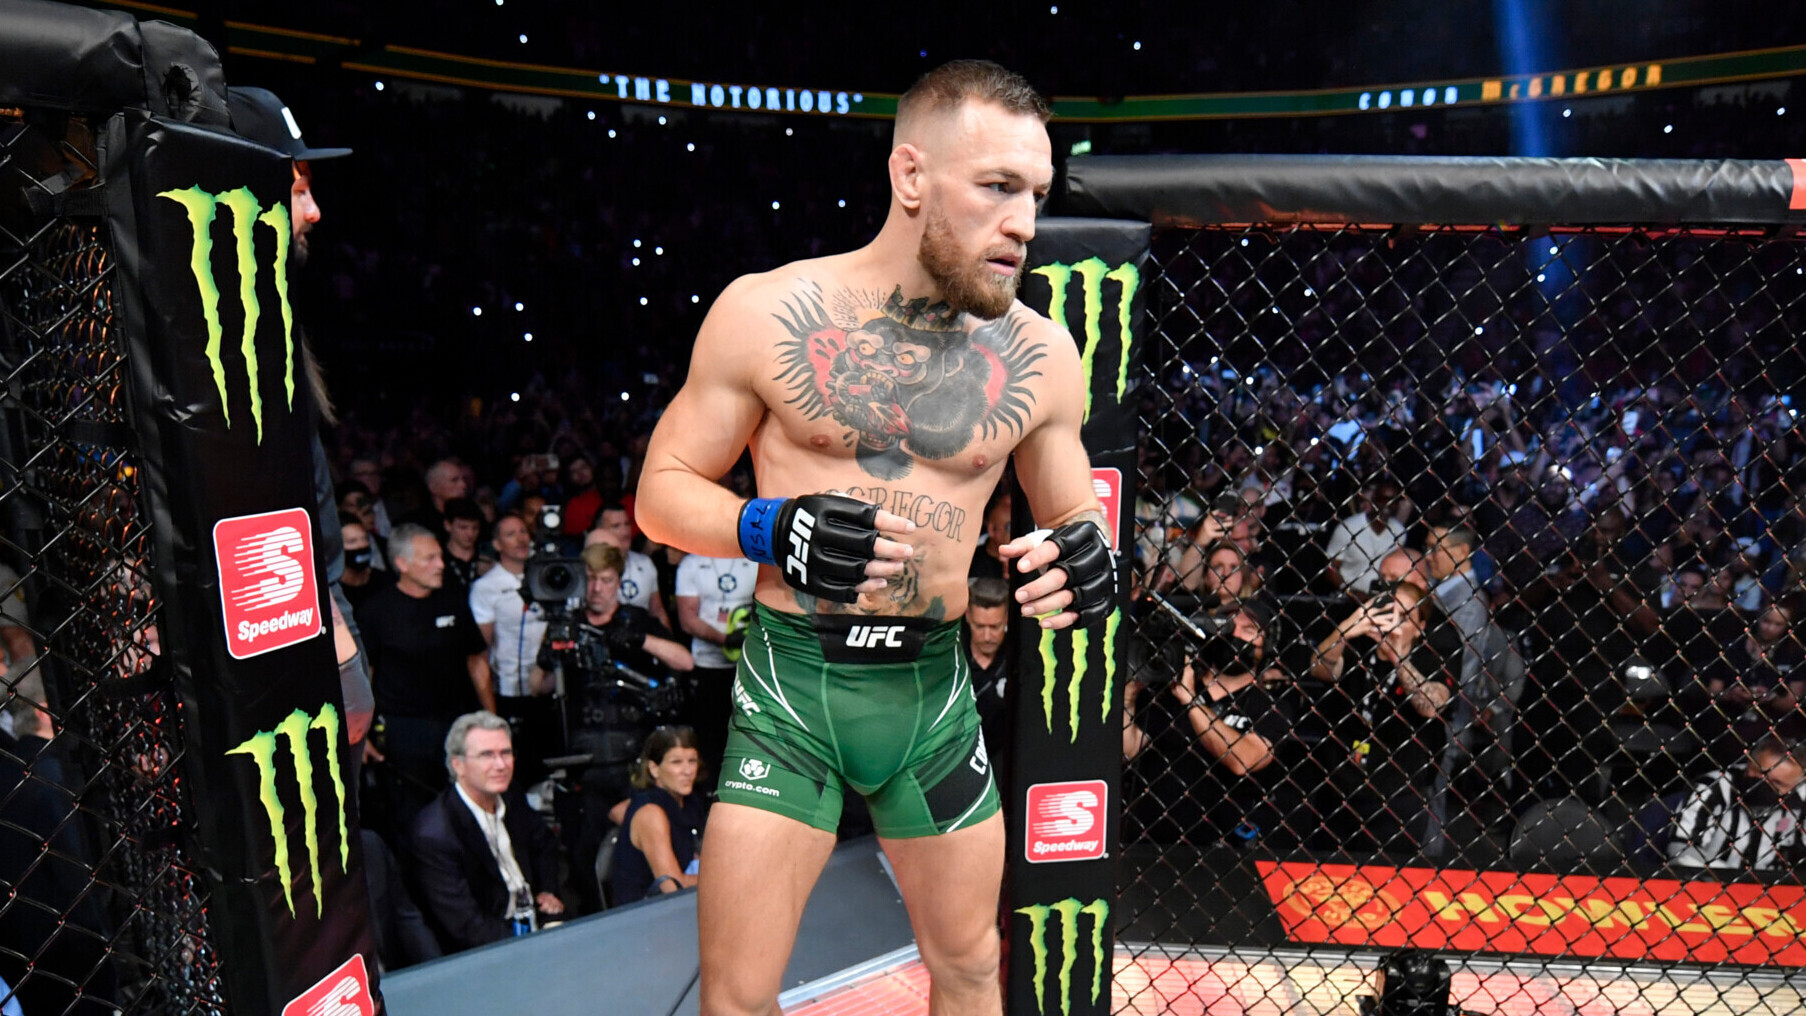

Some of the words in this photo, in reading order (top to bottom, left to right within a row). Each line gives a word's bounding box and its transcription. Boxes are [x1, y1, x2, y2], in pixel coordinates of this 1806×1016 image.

[787, 507, 815, 585] UFC
[237, 607, 314, 642] Speedway
[846, 625, 906, 648] UFC
[735, 680, 761, 716] UFC
[725, 780, 780, 797] crypto.com
[1033, 839, 1099, 855] Speedway
